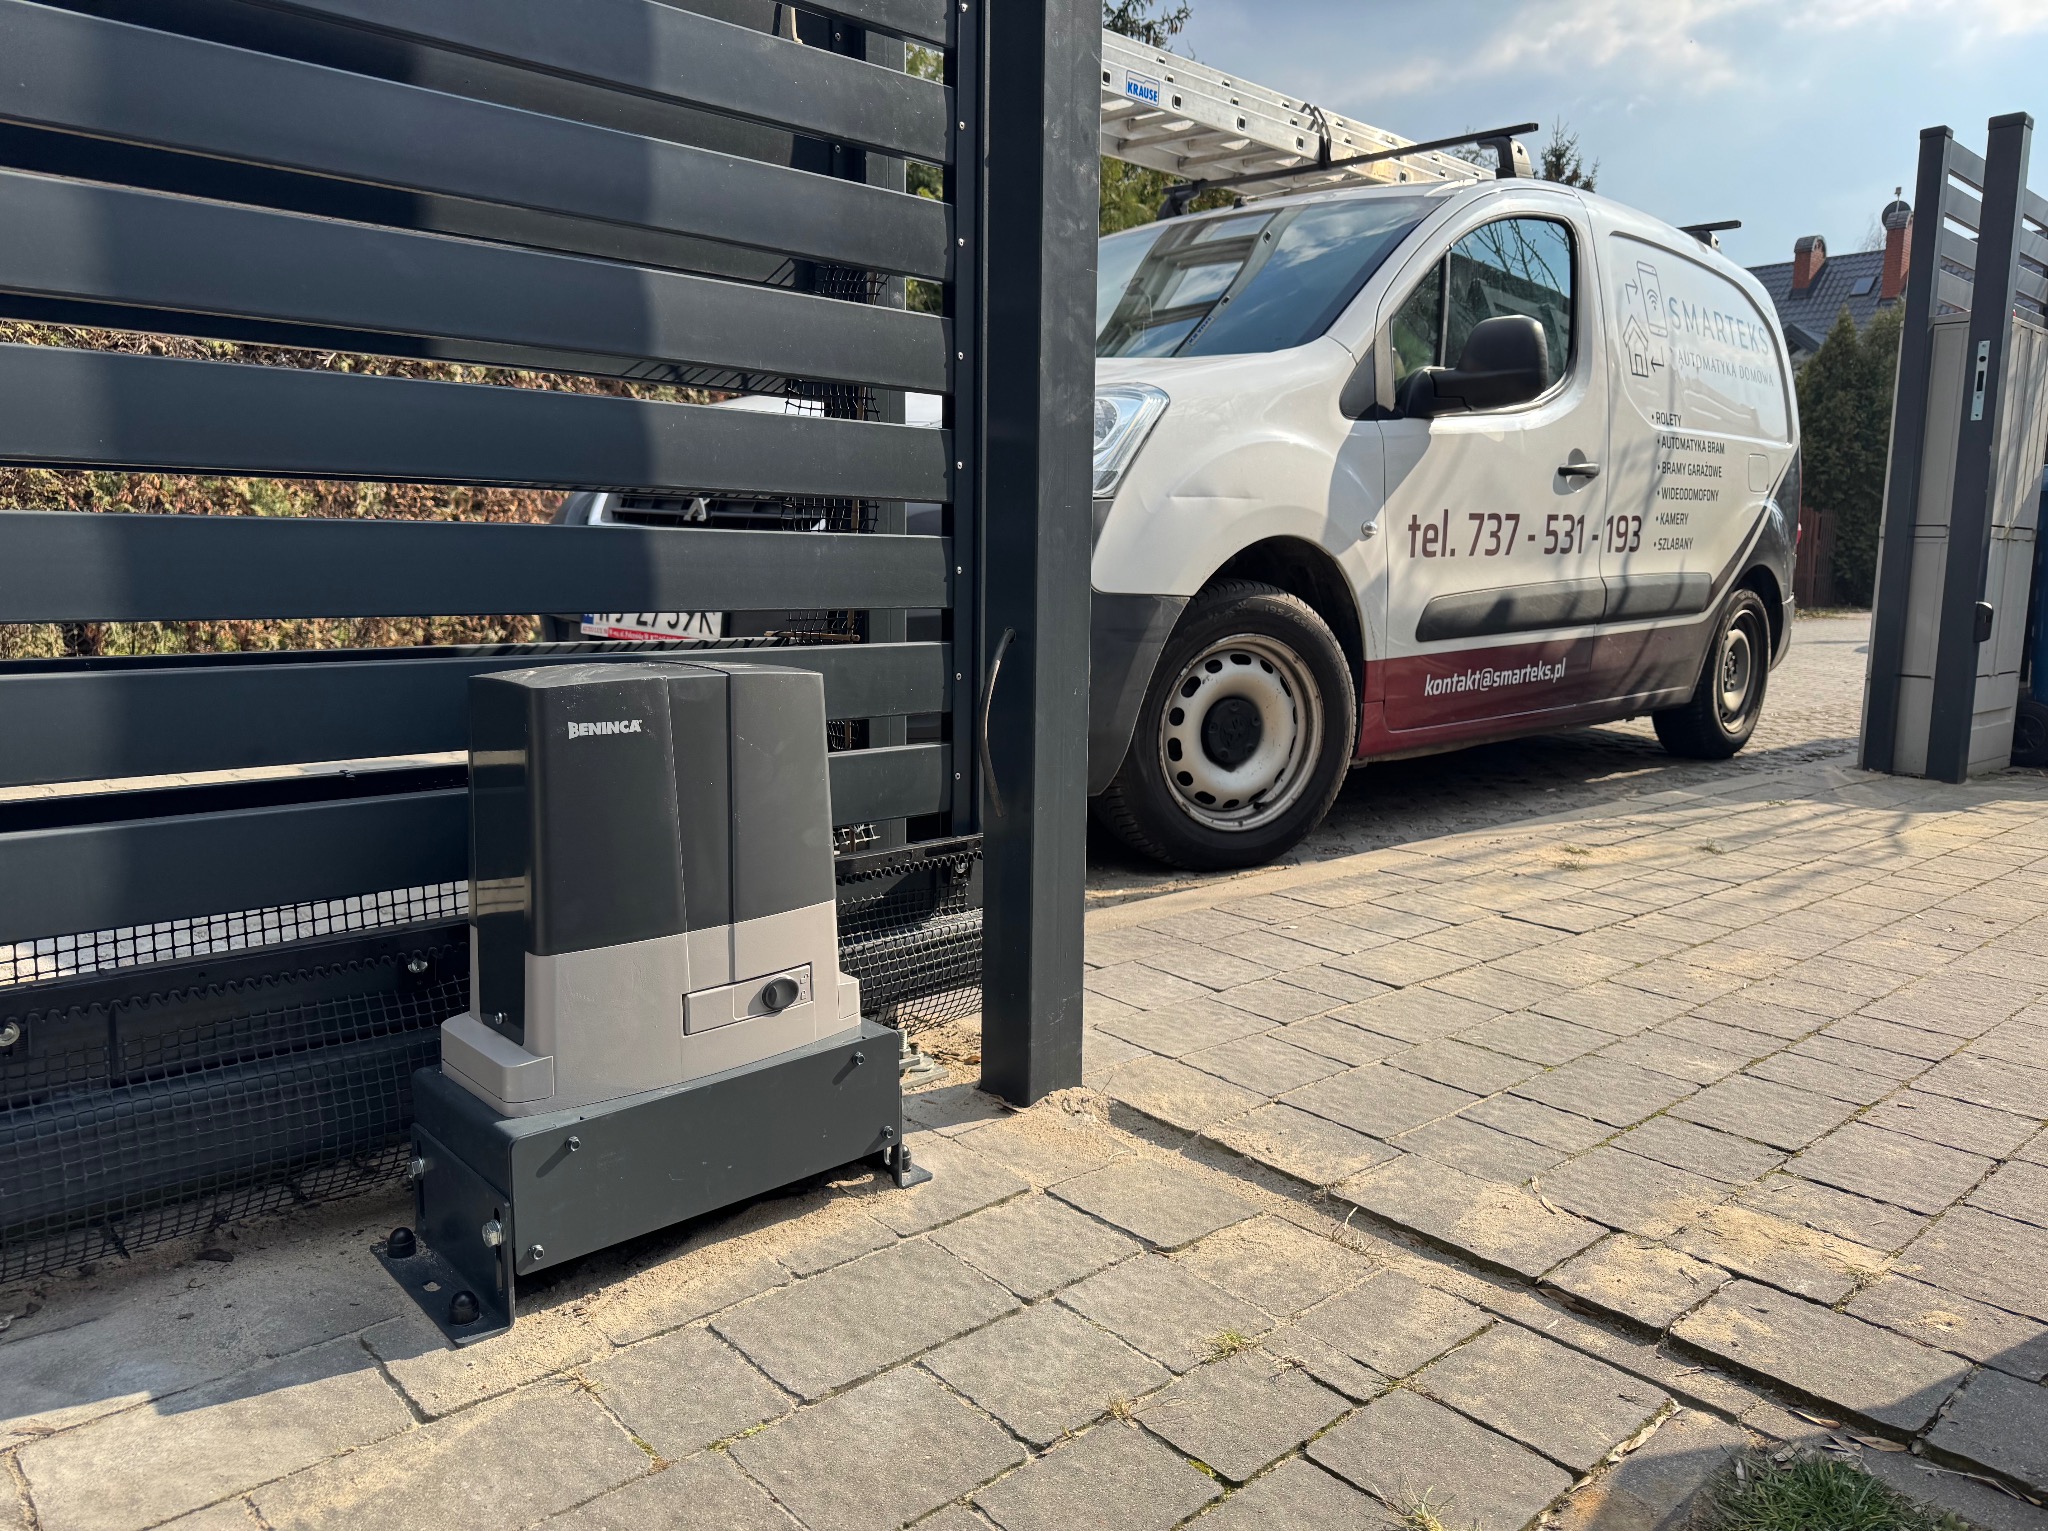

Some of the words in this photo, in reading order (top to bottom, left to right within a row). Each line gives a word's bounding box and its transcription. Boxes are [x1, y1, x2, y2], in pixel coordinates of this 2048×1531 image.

[1127, 81, 1158, 102] KRAUSE
[1668, 297, 1769, 356] SMARTEKS
[1678, 349, 1737, 378] AUTOMATYKA
[1739, 365, 1774, 386] DOMOWA
[1655, 411, 1682, 427] ROLETY
[1661, 435, 1707, 453] AUTOMATYKA
[1707, 441, 1725, 454] BRAM
[1661, 461, 1687, 475] BRAMY
[1687, 461, 1722, 478] GARAŻOWE
[1661, 487, 1719, 502] WIDEODOMOFONY
[1659, 512, 1689, 526] KAMERY
[1408, 509, 1456, 558] tel.
[1468, 513, 1521, 557] 737
[1544, 514, 1585, 555] 531
[1606, 515, 1642, 553] 193
[1657, 537, 1694, 551] SZLABANY
[1424, 657, 1566, 696] kontakt@smarteks.pl
